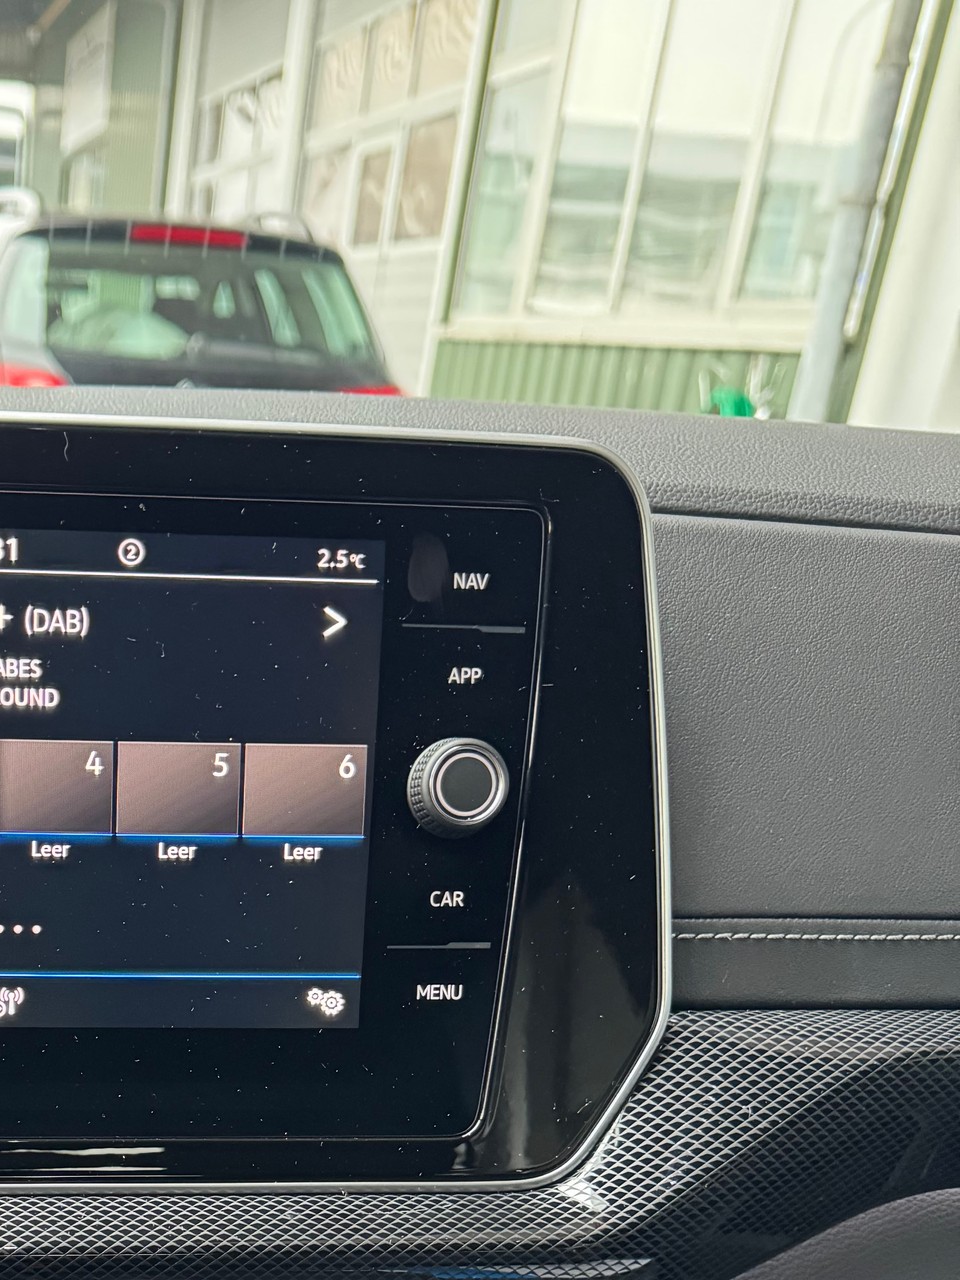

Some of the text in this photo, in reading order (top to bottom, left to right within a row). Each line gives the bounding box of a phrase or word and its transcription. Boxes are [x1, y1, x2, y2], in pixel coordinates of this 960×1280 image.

[453, 571, 489, 591] NAV
[24, 604, 90, 639] (DAB)
[448, 666, 483, 685] APP
[85, 750, 104, 777] 4
[212, 752, 230, 778] 5
[338, 754, 356, 780] 6
[31, 841, 70, 860] Leer
[158, 842, 197, 861] Leer
[283, 844, 322, 862] Leer
[429, 890, 465, 909] CAR
[416, 984, 464, 1002] MENU
